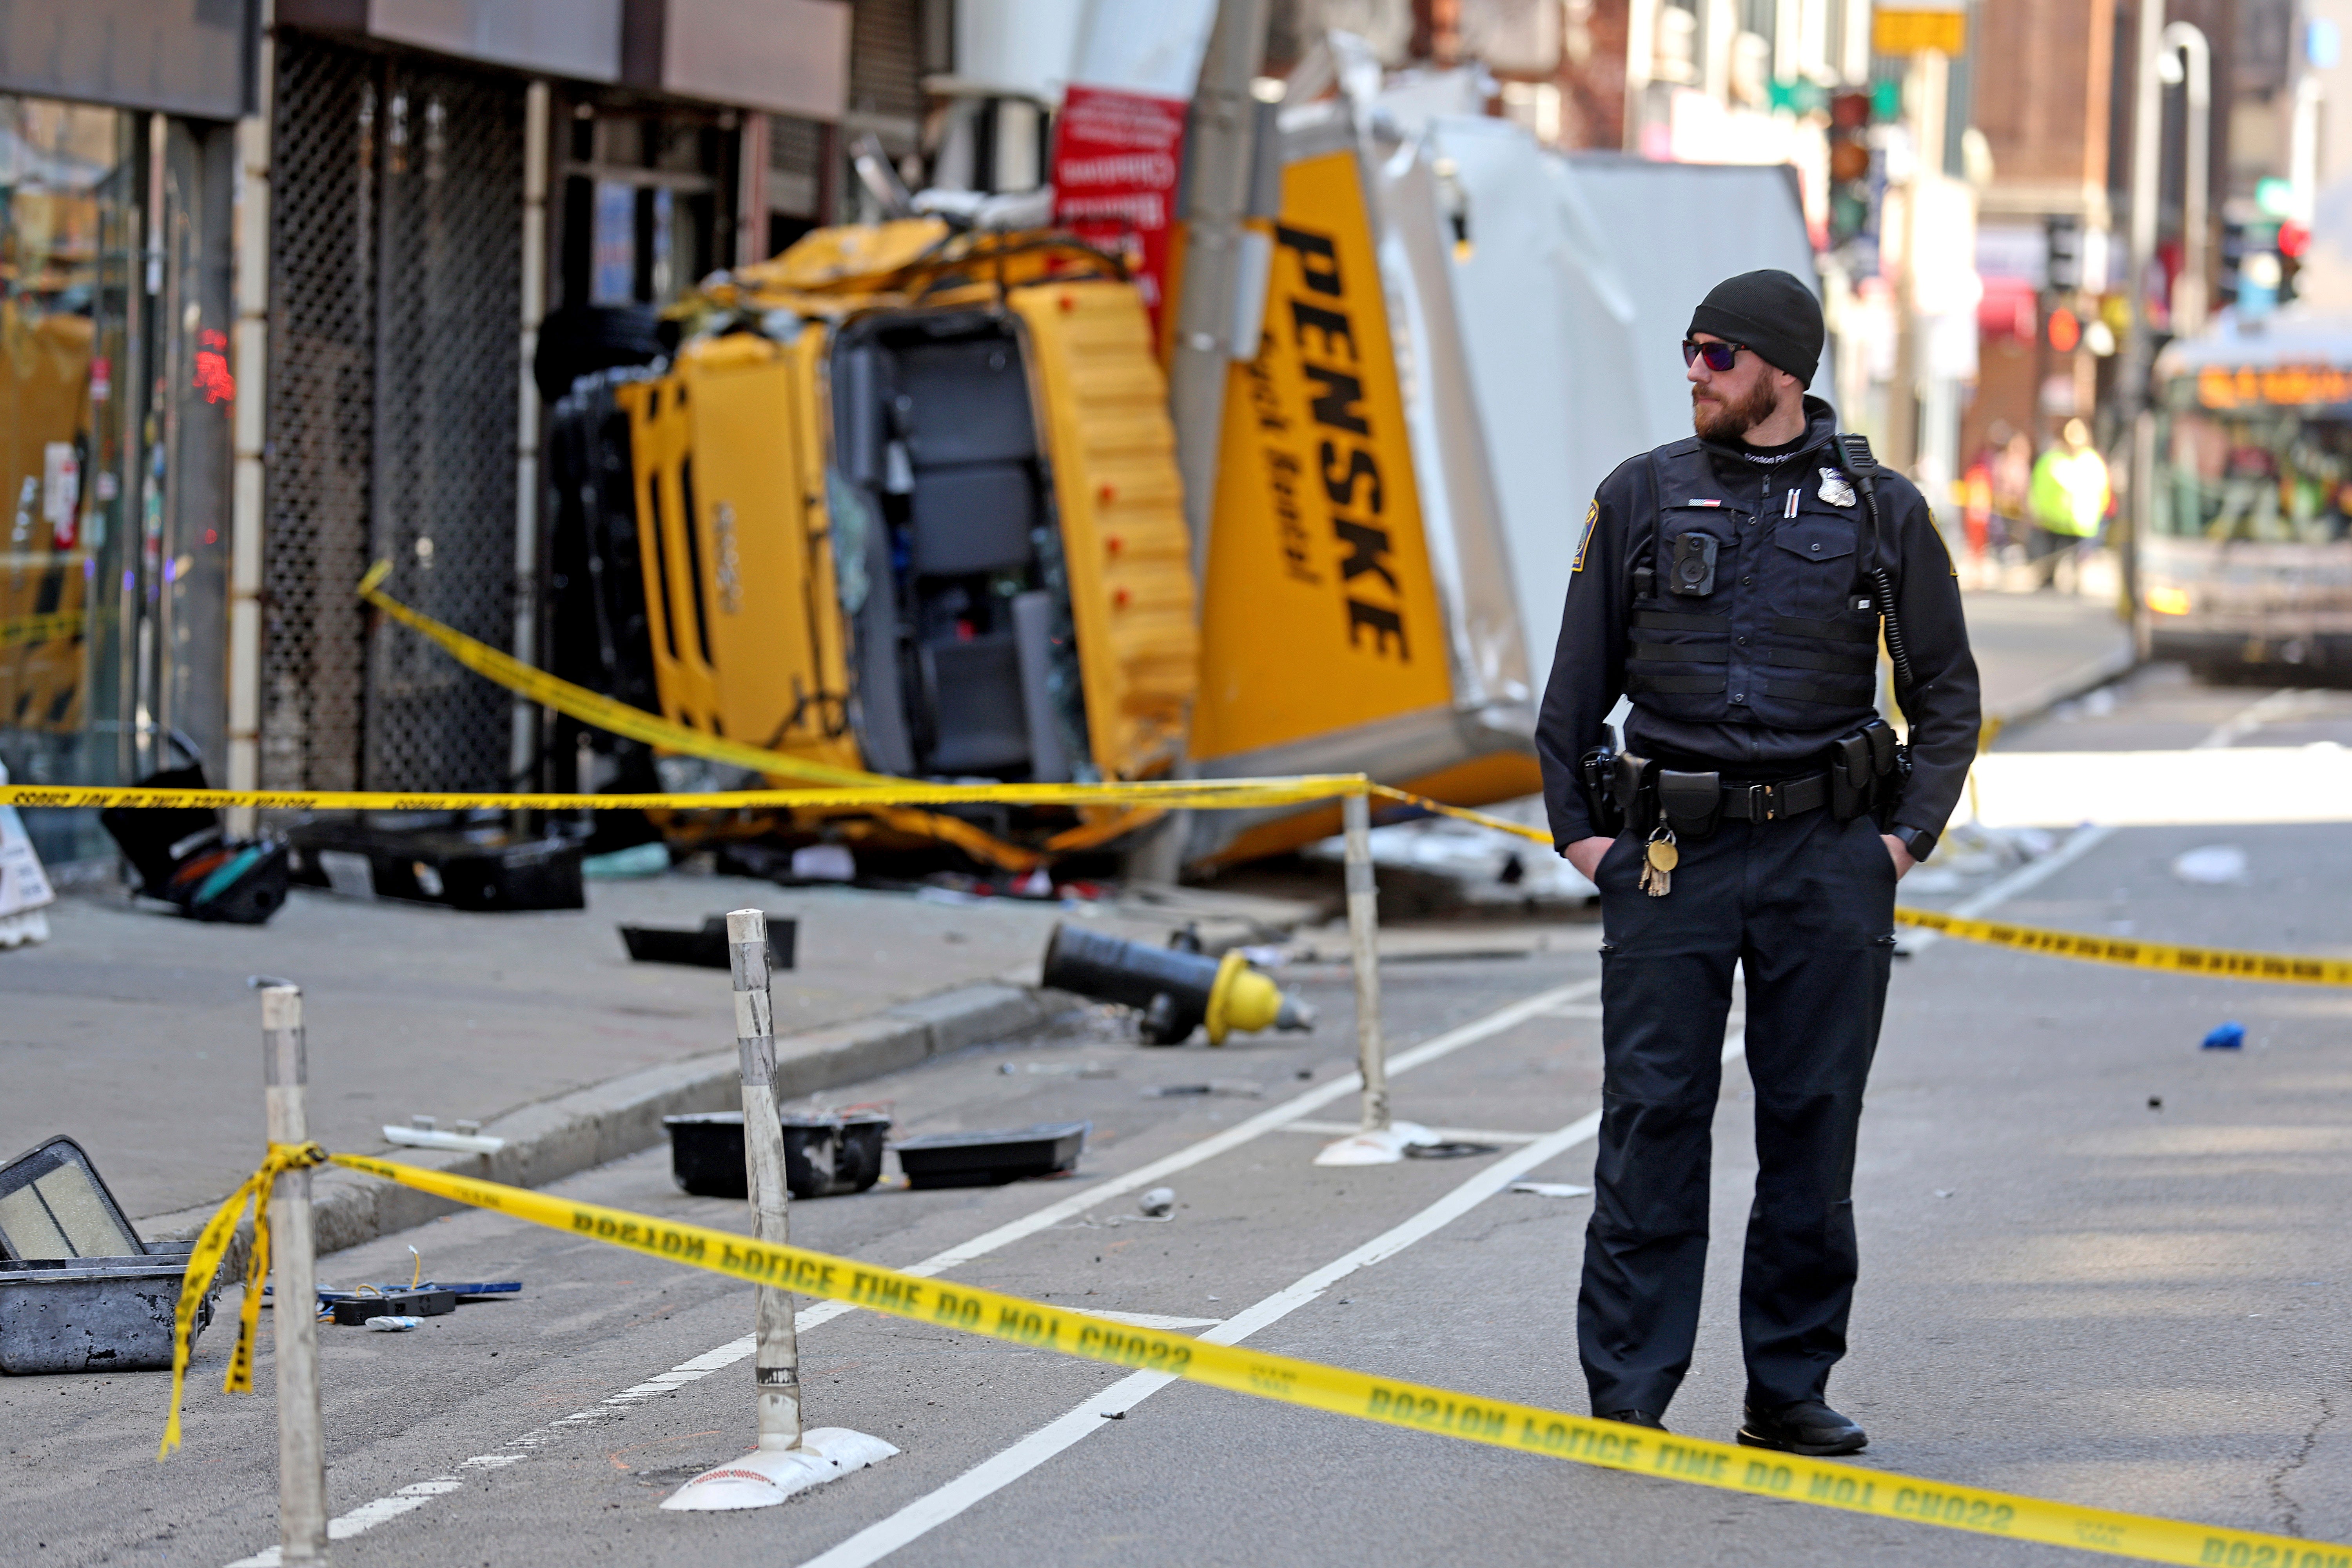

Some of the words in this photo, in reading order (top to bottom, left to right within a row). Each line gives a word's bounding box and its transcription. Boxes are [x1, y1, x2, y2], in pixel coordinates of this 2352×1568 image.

[1275, 224, 1412, 662] PENSKE
[1744, 452, 1775, 464] Boston
[1775, 451, 1797, 464] Pol
